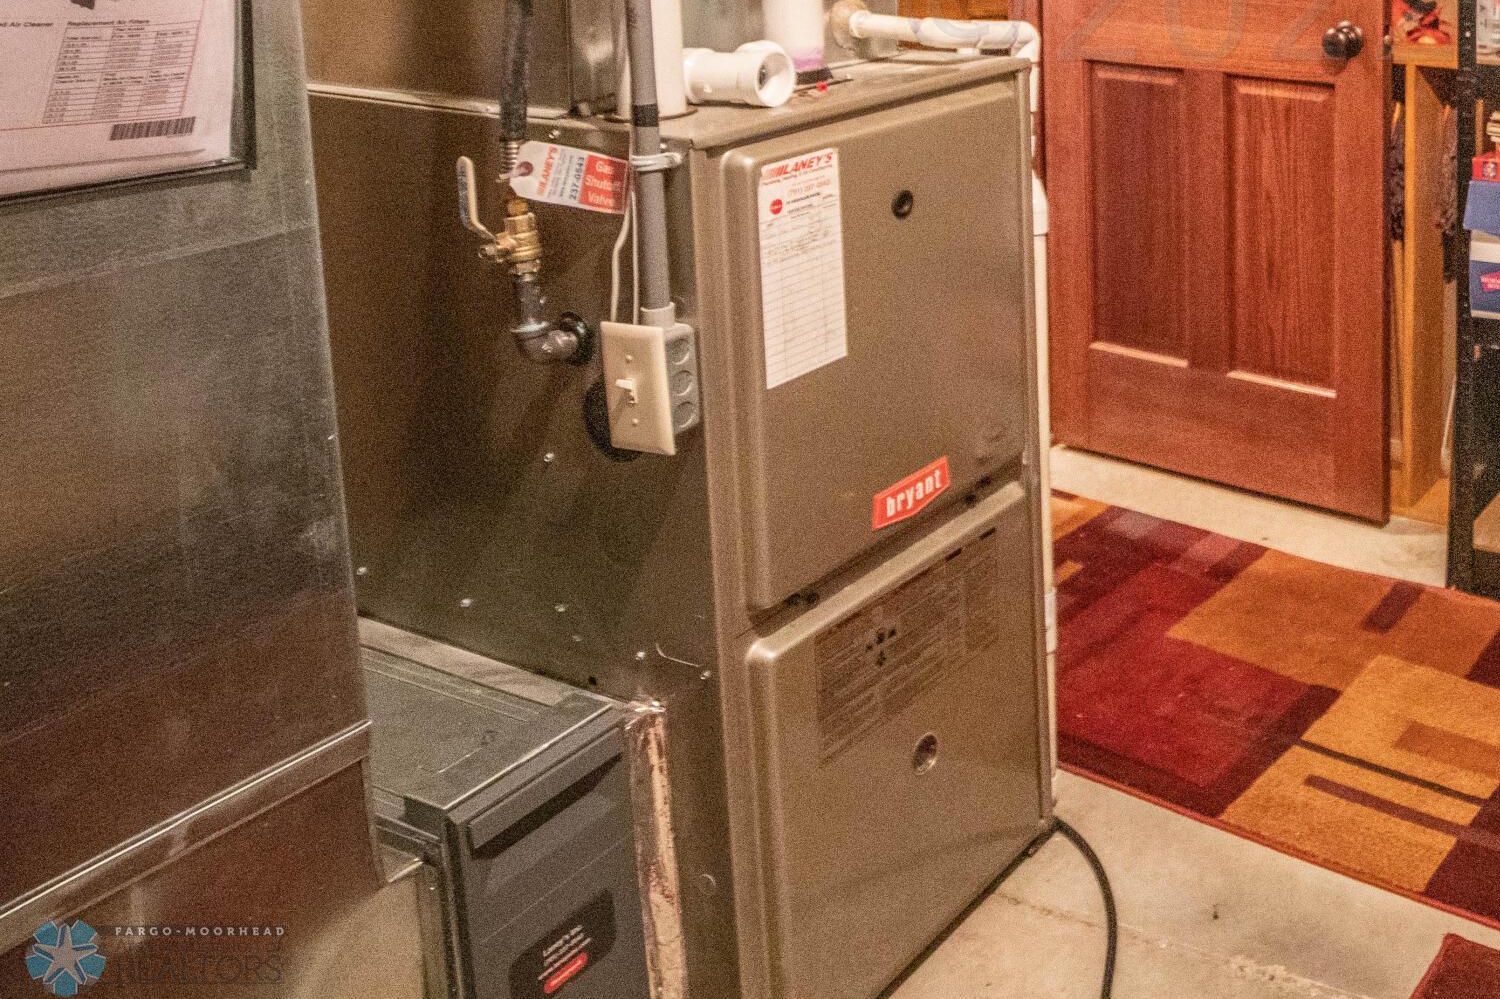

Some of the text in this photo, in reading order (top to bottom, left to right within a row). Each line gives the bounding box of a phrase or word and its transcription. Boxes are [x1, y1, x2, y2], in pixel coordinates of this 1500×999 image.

[569, 156, 585, 201] 237-0543
[781, 152, 834, 177] LANEY'S
[885, 468, 942, 519] bryant
